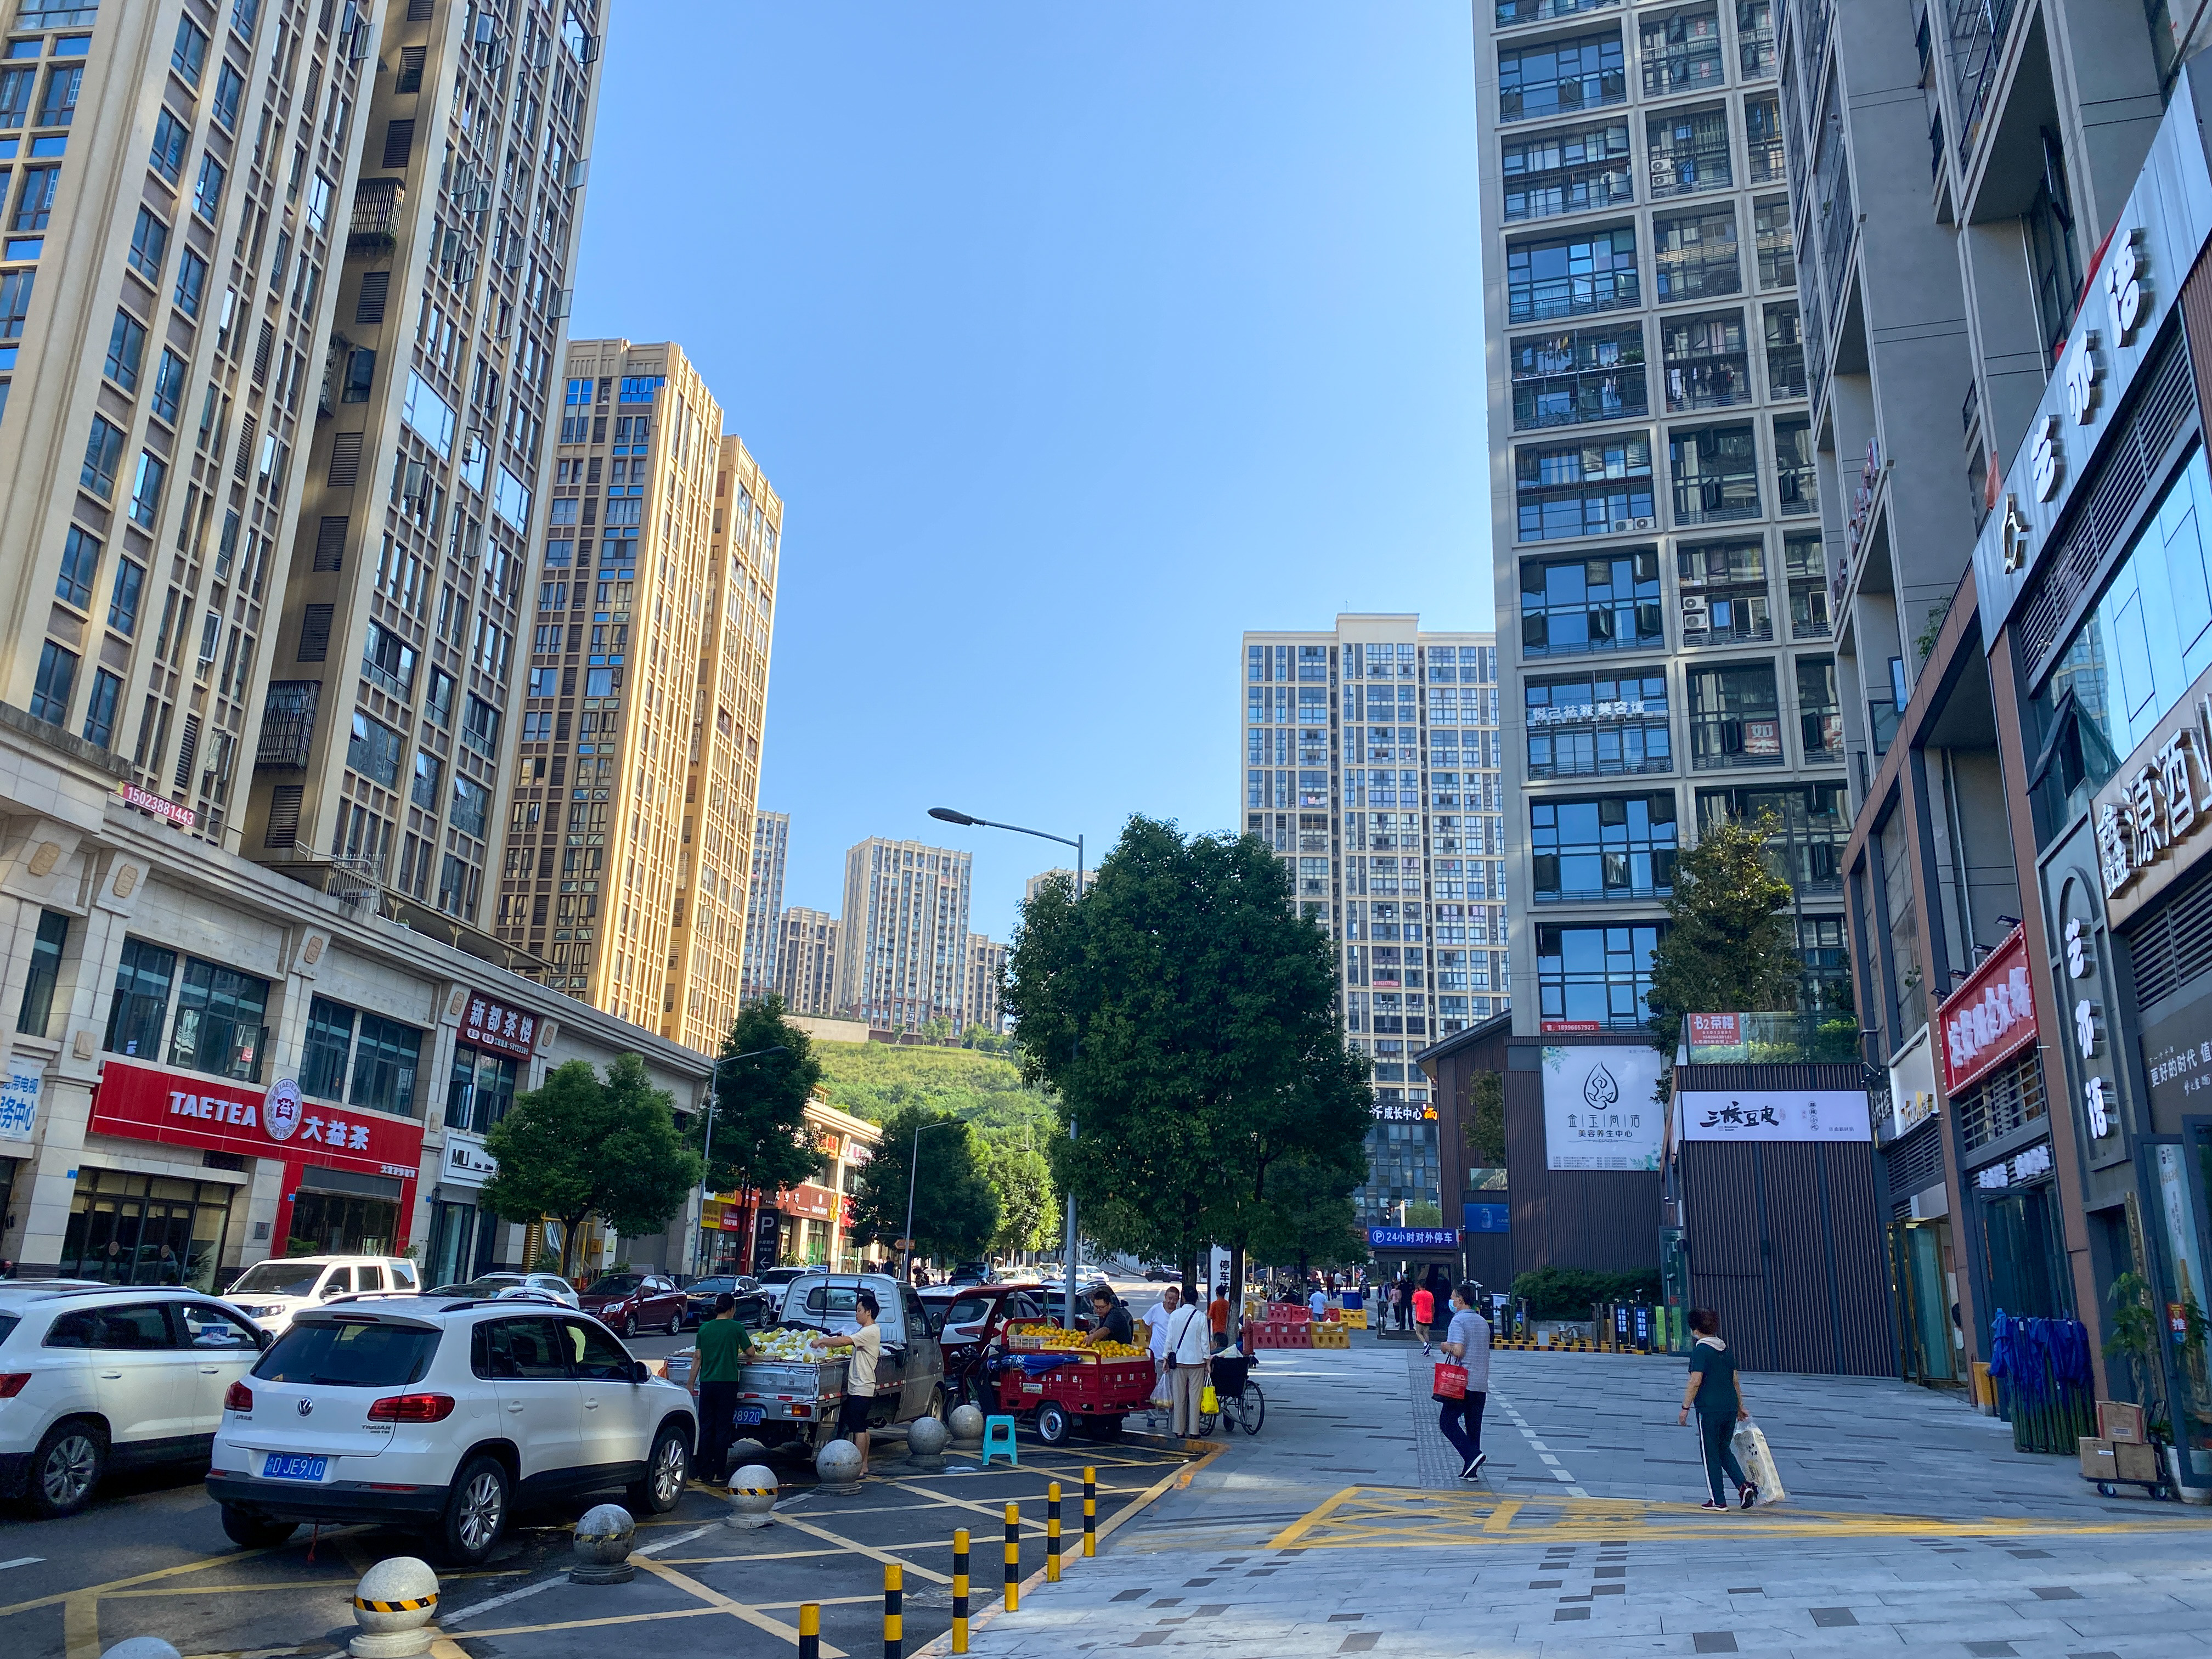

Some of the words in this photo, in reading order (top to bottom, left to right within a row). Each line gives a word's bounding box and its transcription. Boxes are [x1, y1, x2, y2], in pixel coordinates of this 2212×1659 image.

[1533, 701, 1645, 720] 悦己祛斑美容馆
[128, 786, 194, 825] 15023881443
[469, 998, 534, 1044] 新都茶楼
[2150, 1048, 2197, 1088] 更好的时代
[2200, 1038, 2212, 1063] 值
[170, 1091, 256, 1127] TAETEA
[301, 1116, 370, 1150] 大益茶
[1578, 1130, 1633, 1138] 美容养生中心
[760, 1216, 775, 1234] P
[1386, 1231, 1453, 1244] 24小时对外停车
[2172, 1318, 2187, 1330] 推
